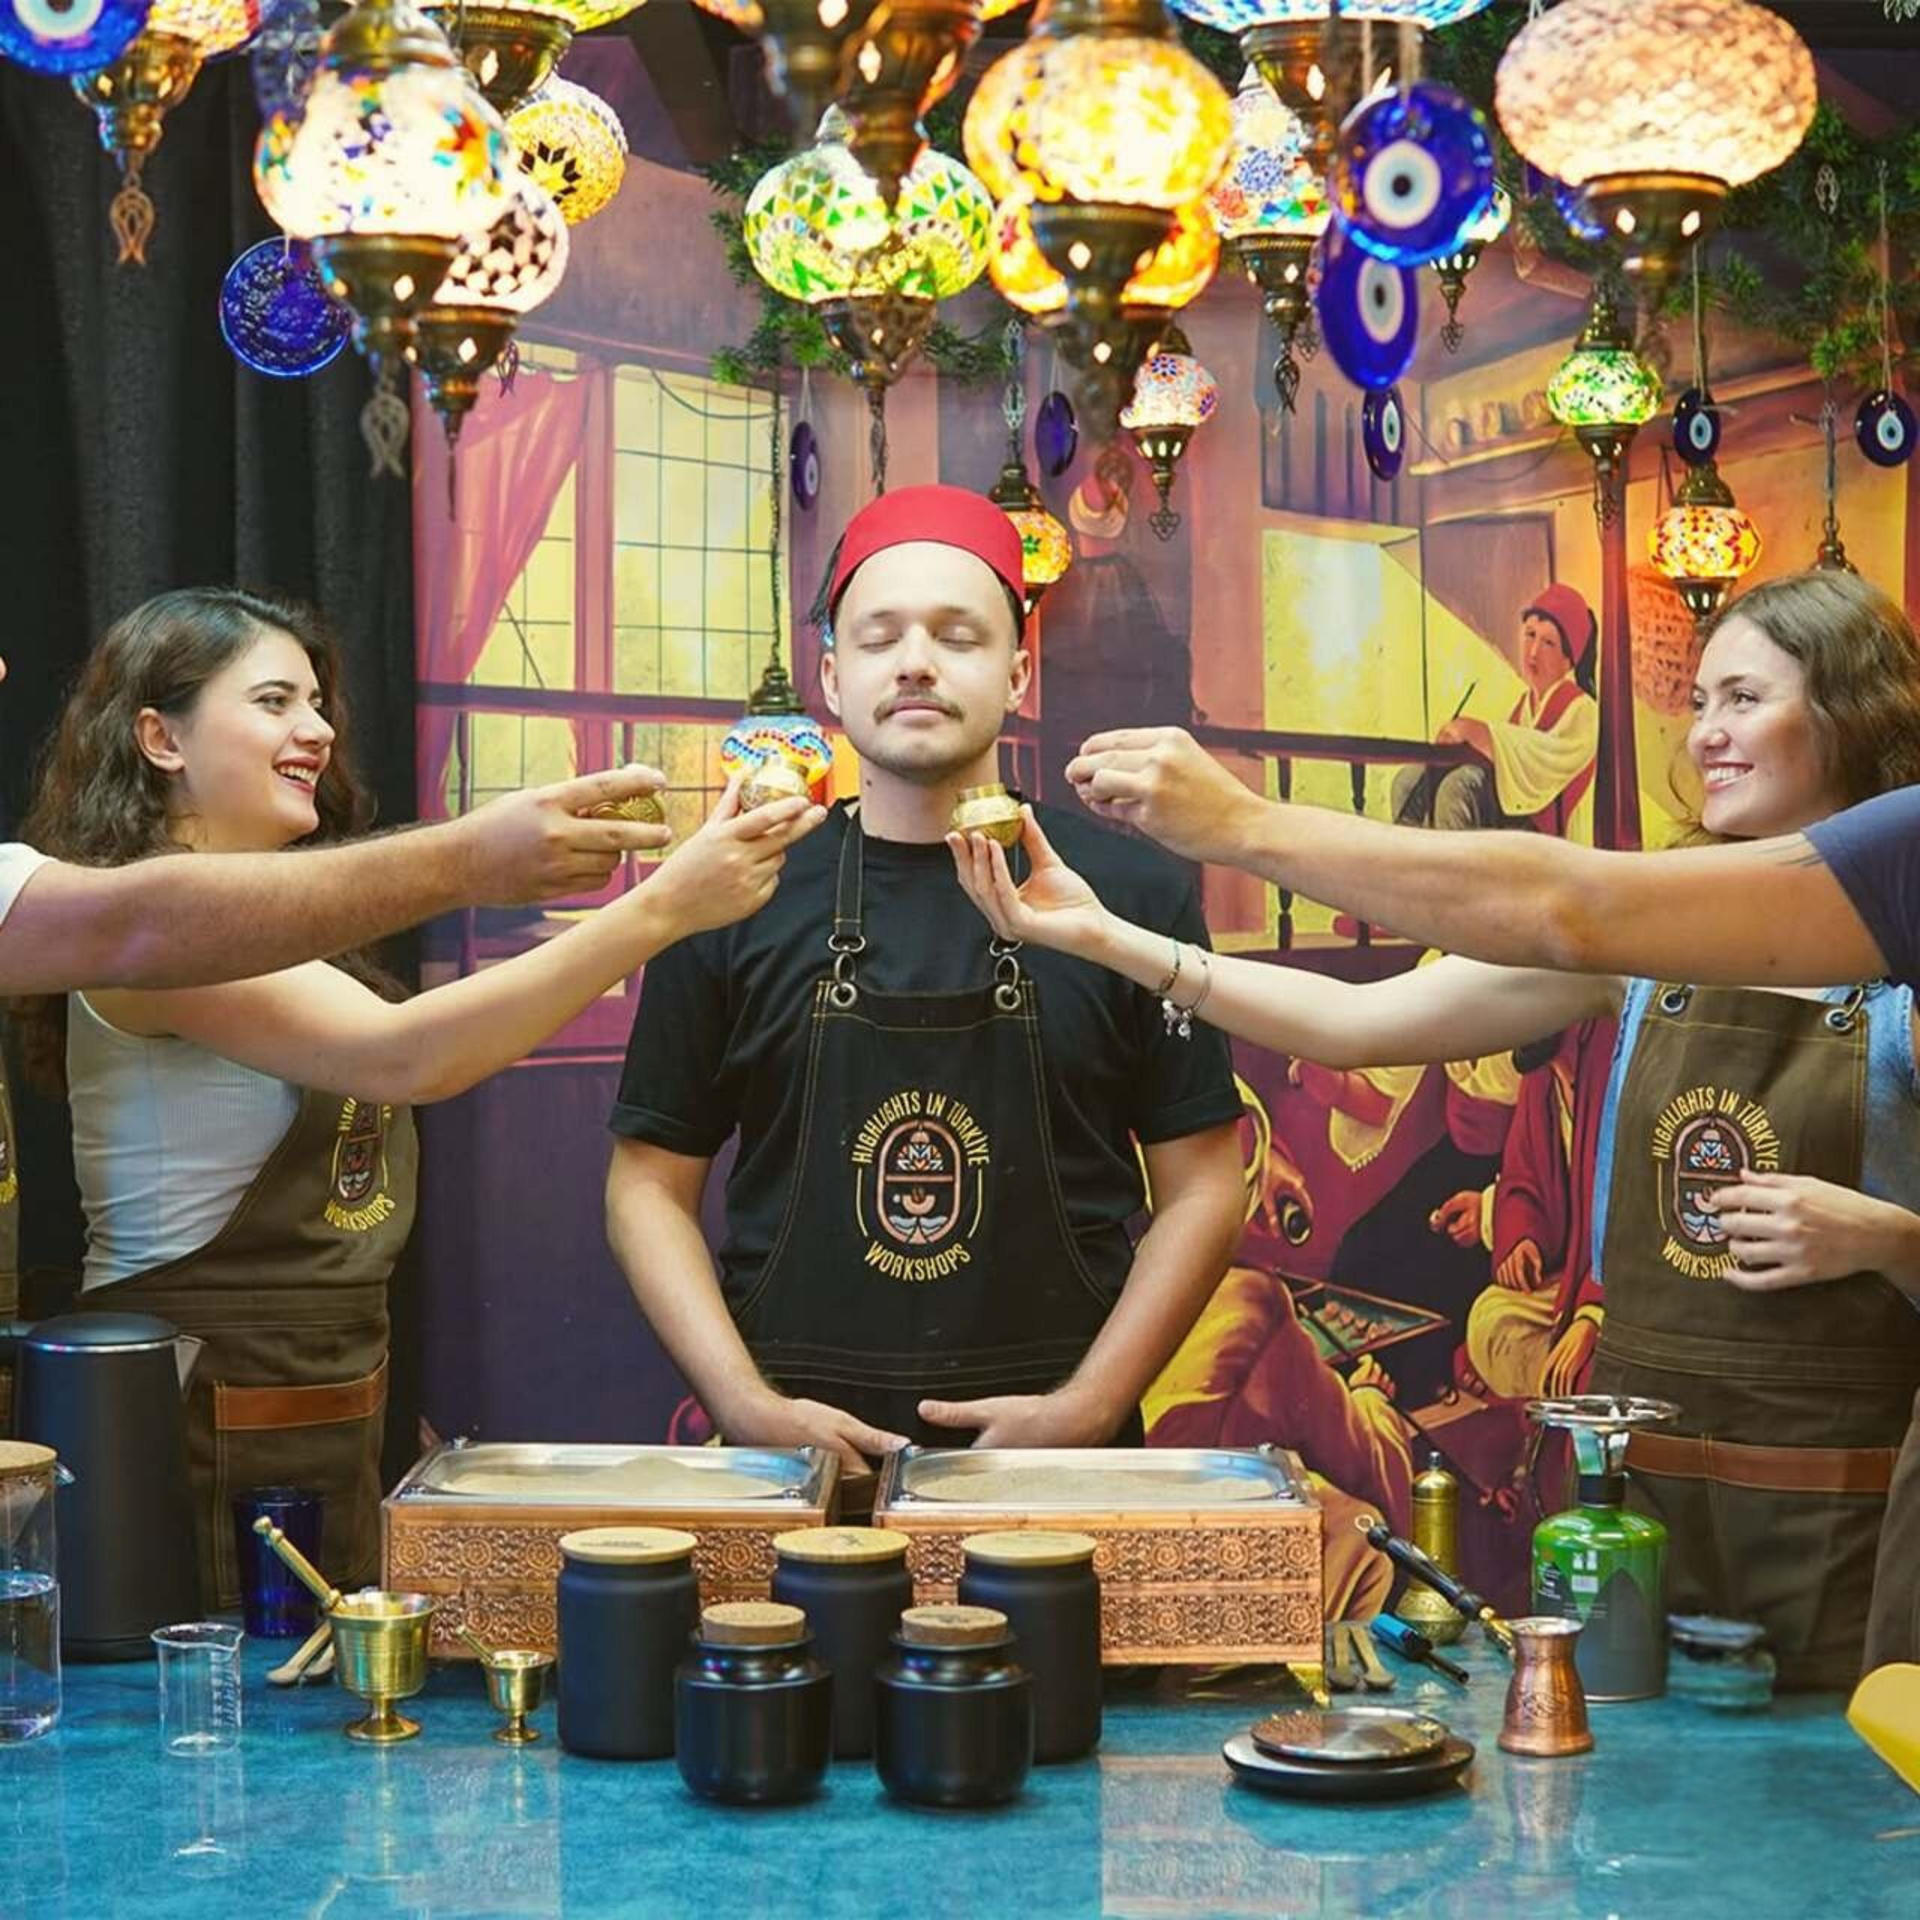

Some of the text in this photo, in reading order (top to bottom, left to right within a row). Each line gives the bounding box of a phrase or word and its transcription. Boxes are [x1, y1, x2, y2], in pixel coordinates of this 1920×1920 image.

[851, 1091, 920, 1164] HIGHLIGHTS
[926, 1092, 947, 1117] IN
[1653, 1086, 1715, 1158] HIGHLIGHTS
[1719, 1088, 1740, 1115] IN
[864, 1240, 971, 1281] WORKSHOPS
[1662, 1235, 1741, 1279] WORKSHOP
